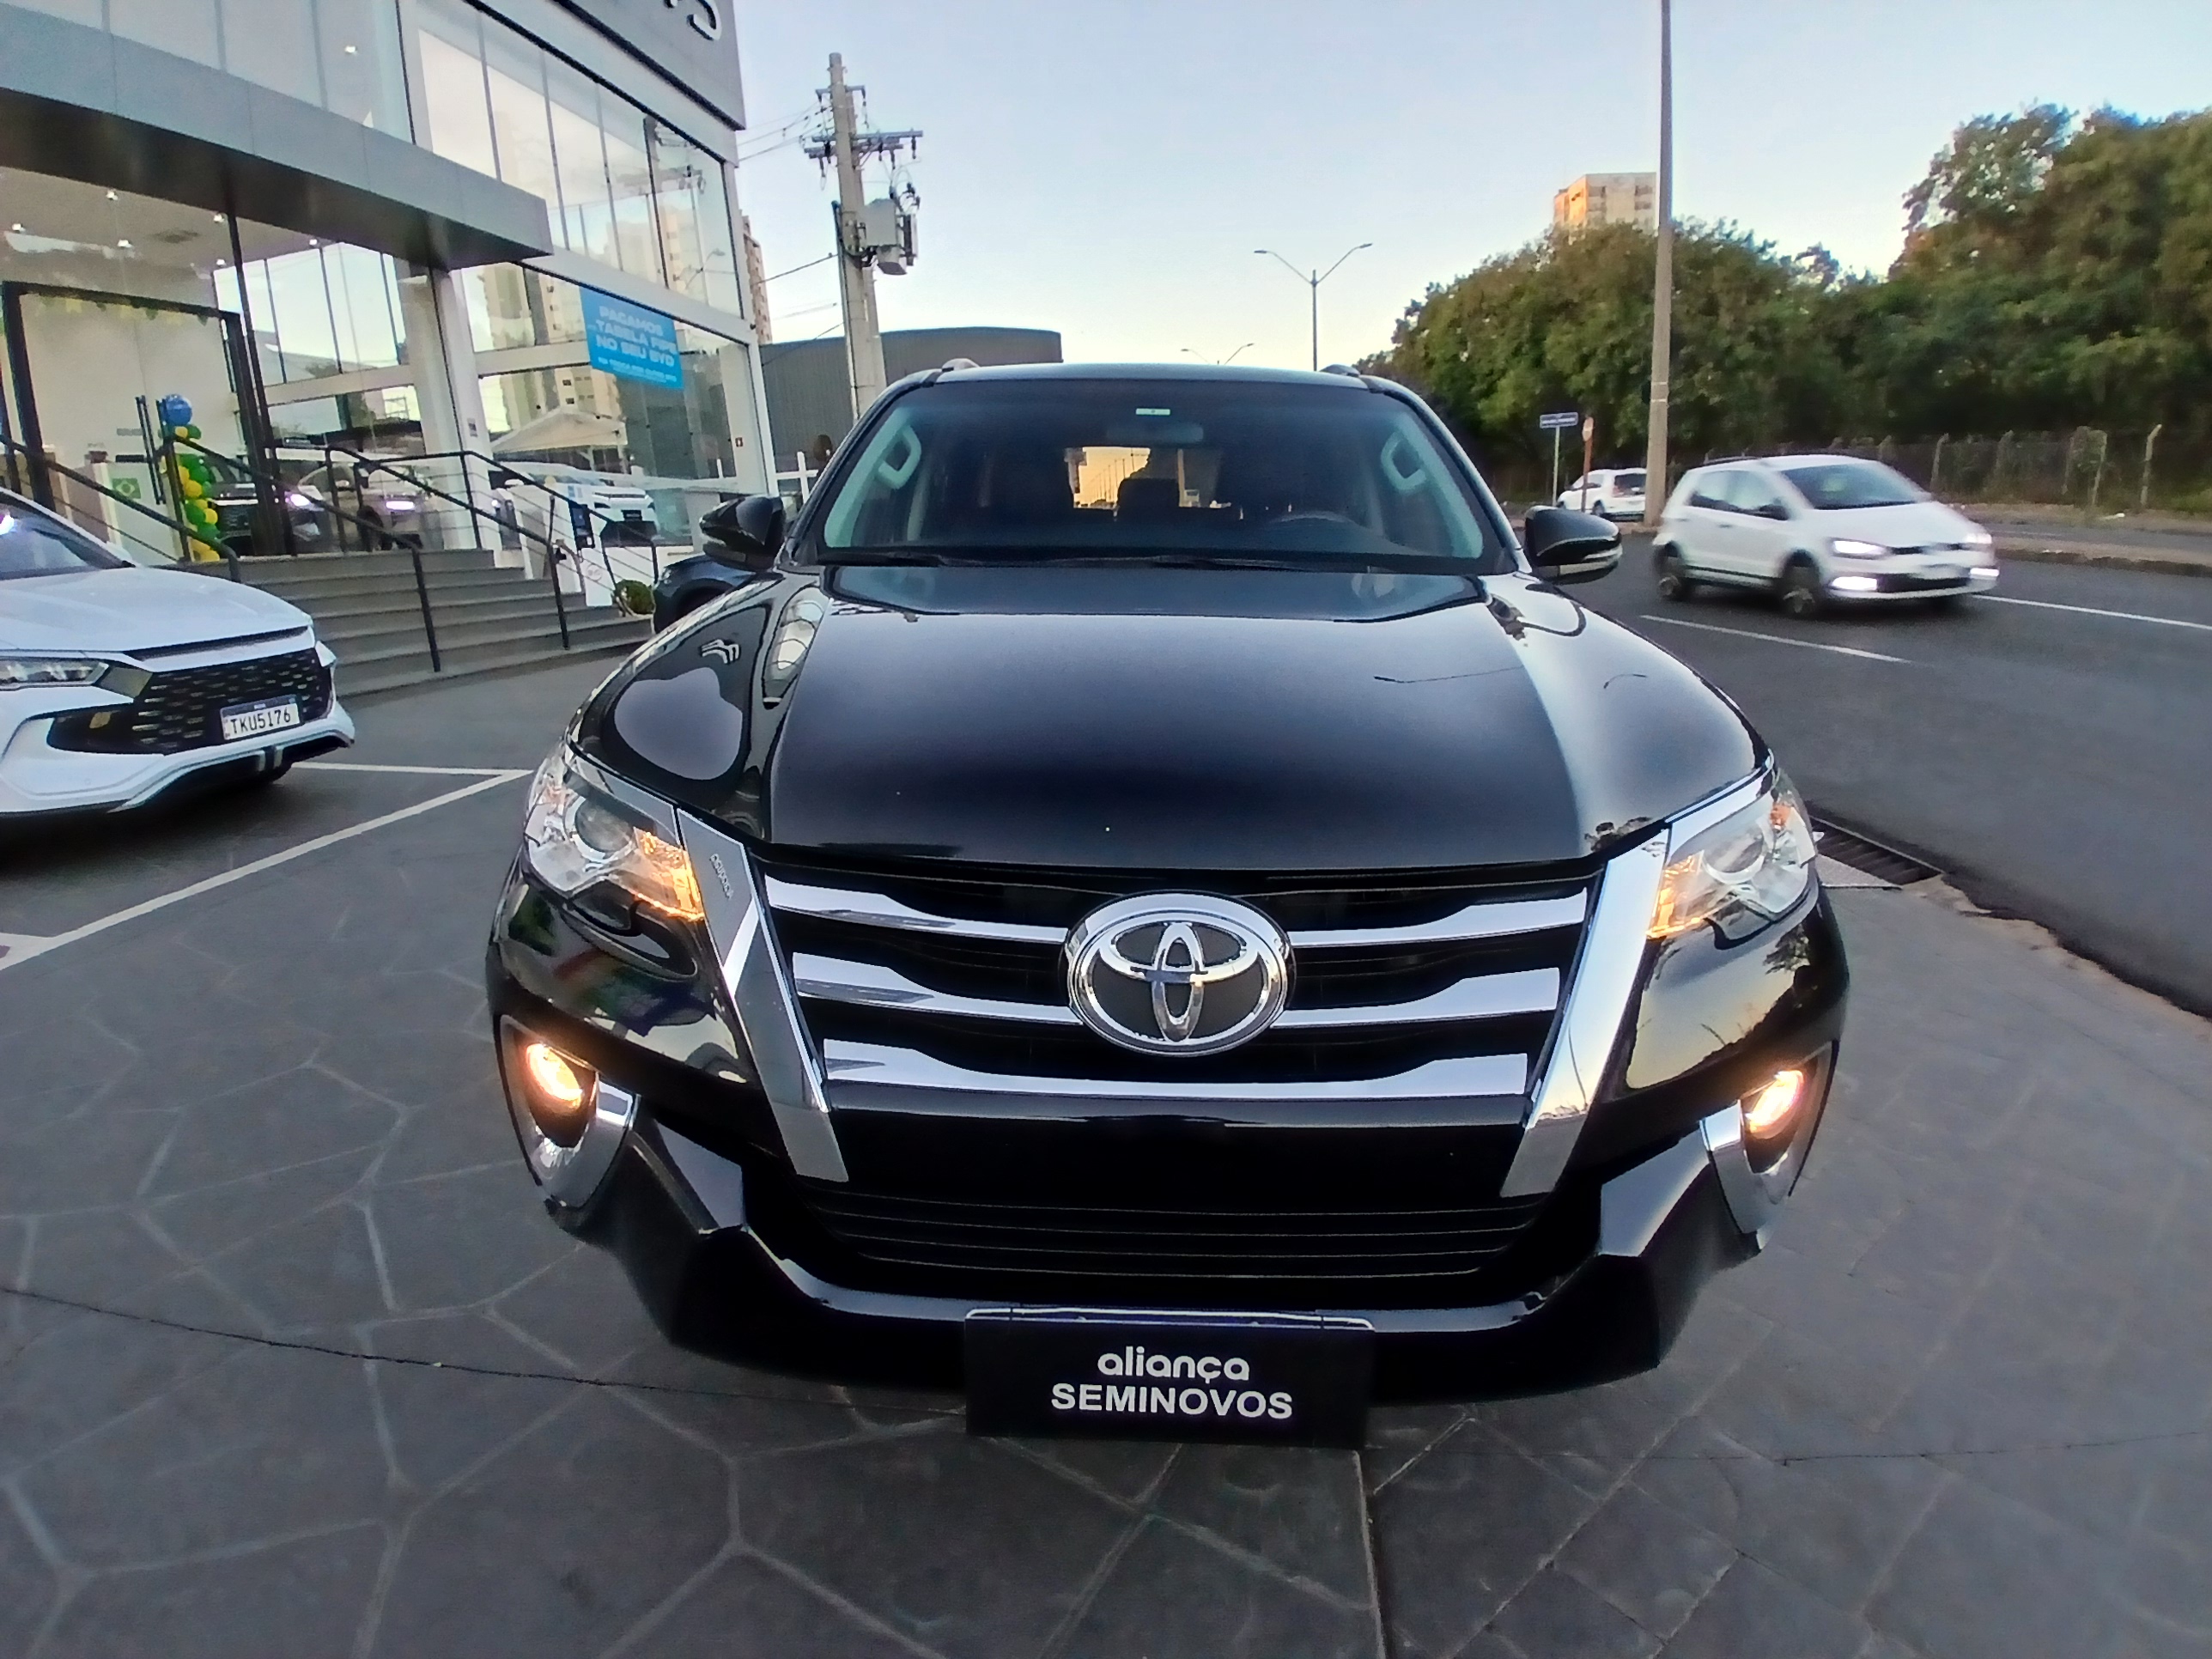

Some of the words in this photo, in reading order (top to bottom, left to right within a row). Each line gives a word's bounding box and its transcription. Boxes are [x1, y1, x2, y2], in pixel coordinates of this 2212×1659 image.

[596, 319, 648, 346] TABELA
[599, 306, 663, 336] PAGAMOS
[596, 334, 617, 350] NO
[1097, 1346, 1249, 1384] aliança
[1051, 1382, 1293, 1419] SEMINOVOS
